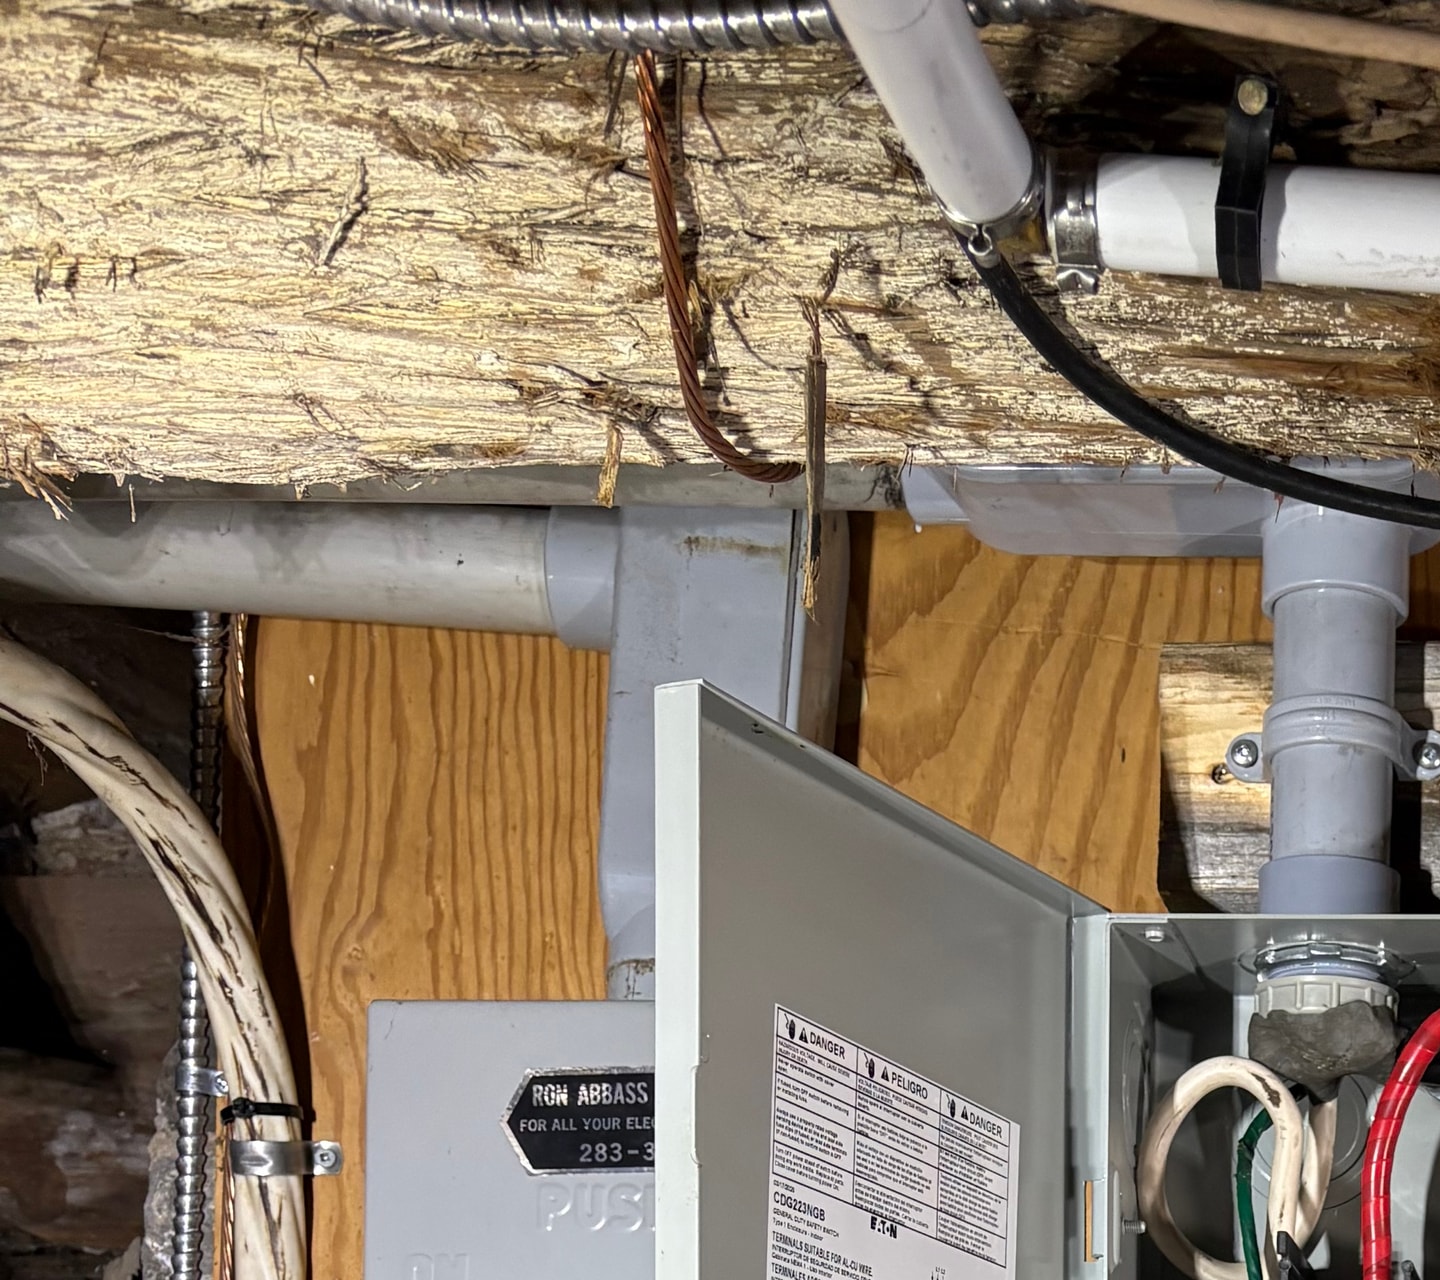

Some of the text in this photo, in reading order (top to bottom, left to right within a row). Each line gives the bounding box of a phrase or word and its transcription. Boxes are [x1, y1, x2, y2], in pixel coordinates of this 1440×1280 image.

[810, 1031, 845, 1060] DANGER
[532, 1082, 649, 1106] RON ABBASS
[891, 1071, 927, 1100] PELIGRO
[519, 1119, 547, 1132] FOR
[551, 1118, 577, 1131] ALL
[582, 1117, 621, 1130] YOUR
[969, 1111, 1002, 1138] DANGER
[773, 1189, 825, 1222] CDG223NGB
[772, 1229, 803, 1251] TERMINALS
[803, 1241, 829, 1261] SUITABLE
[830, 1251, 841, 1265] FOR
